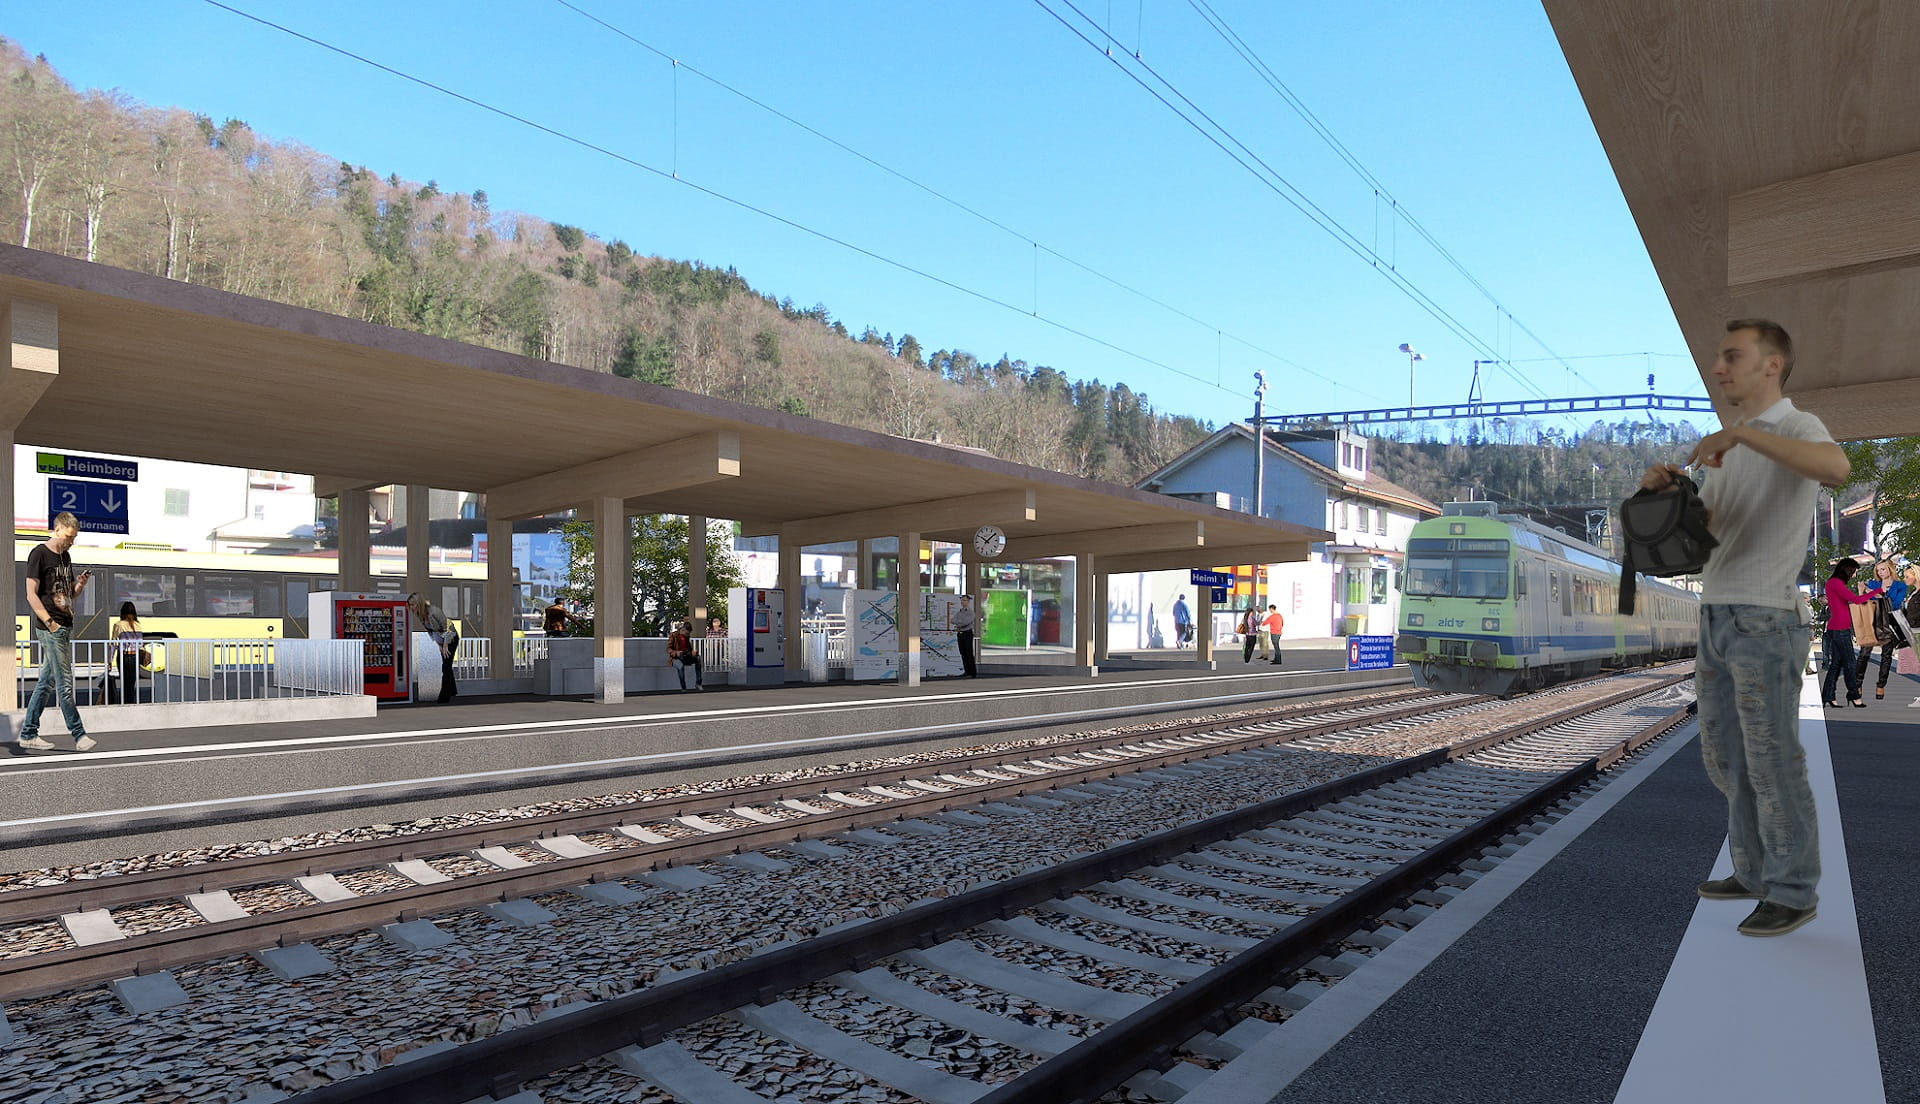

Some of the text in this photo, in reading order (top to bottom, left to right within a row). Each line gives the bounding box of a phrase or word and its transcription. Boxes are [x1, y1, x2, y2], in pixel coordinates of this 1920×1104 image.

[67, 459, 136, 479] Heimberg
[62, 491, 77, 509] 2
[1217, 592, 1222, 601] 1
